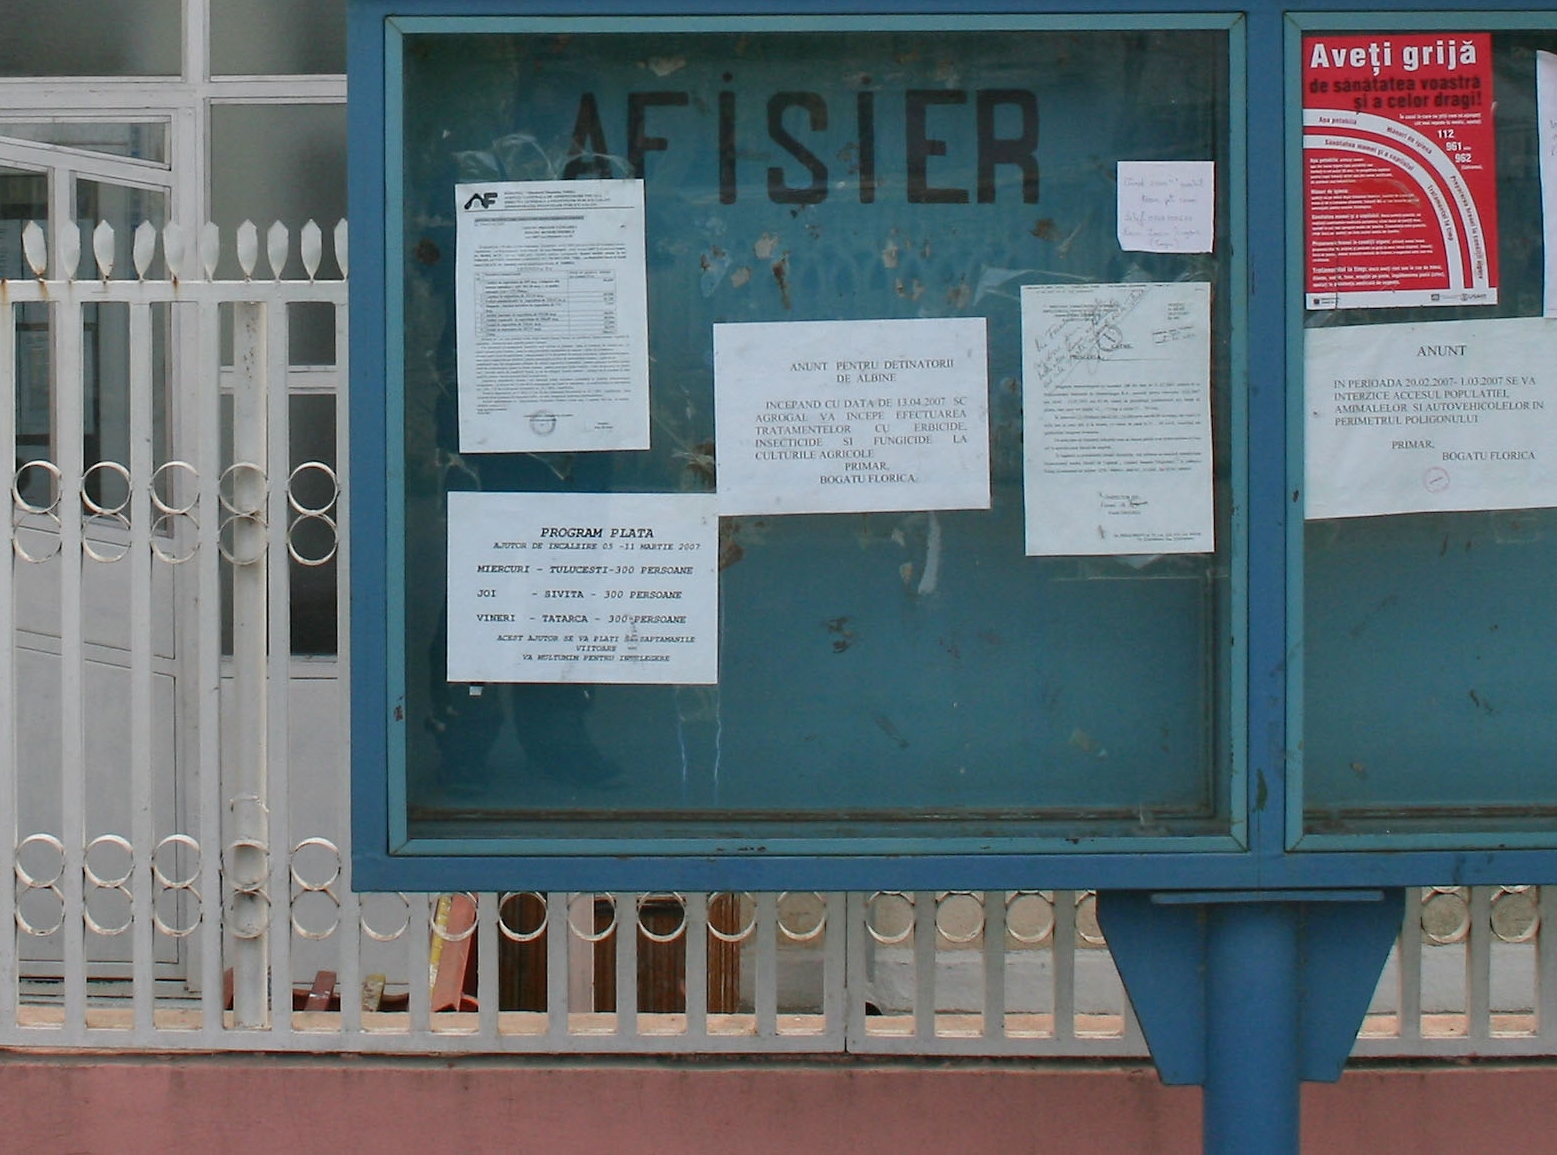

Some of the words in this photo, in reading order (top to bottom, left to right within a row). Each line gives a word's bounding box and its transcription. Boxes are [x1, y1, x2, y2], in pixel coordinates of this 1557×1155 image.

[1402, 40, 1477, 71] grijă
[1309, 78, 1328, 93] de
[1373, 97, 1382, 108] a
[1387, 94, 1430, 108] celor
[1438, 129, 1455, 138] 112
[1417, 345, 1467, 357] ANUNT
[790, 362, 828, 371] ANUNT
[836, 360, 878, 370] PENTRU
[884, 359, 954, 369] DETINATORII
[836, 374, 850, 383] DE
[857, 373, 897, 383] ALBINE
[1334, 380, 1345, 389] IN
[1348, 379, 1402, 388] PERIOADA
[1506, 376, 1518, 385] SE
[1521, 376, 1536, 385] VA
[1334, 391, 1390, 401] INTERZICE
[1394, 390, 1441, 400] ACCESUL
[766, 400, 821, 409] INCEPAND
[825, 400, 840, 408] CU
[844, 399, 874, 408] DATA
[878, 398, 892, 407] DE
[953, 397, 968, 405] SC
[1412, 403, 1422, 412] SI
[1532, 401, 1544, 410] IN
[755, 413, 808, 423] AGROGAL
[820, 413, 835, 421] VA
[846, 412, 884, 421] INCEPE
[896, 409, 967, 420] EFECTUAREA
[1335, 416, 1402, 426] PERIMETRUL
[1405, 415, 1478, 425] POLIGONULUI
[755, 425, 851, 435] TRATAMENTELOR
[875, 424, 890, 433] CU
[755, 438, 823, 448] INSECTICIDE
[843, 437, 853, 445] SI
[874, 435, 932, 445] FUNGICIDE
[953, 435, 967, 444] LA
[755, 450, 816, 461] CULTURILE
[819, 449, 874, 459] AGRICOLE
[1442, 451, 1487, 461] BOGATU
[1490, 451, 1536, 460] FLORICA
[820, 474, 865, 484] BOGATU
[868, 474, 916, 483] FLORICA
[540, 527, 603, 538] PROGRAM
[610, 528, 654, 538] PLATA
[678, 543, 701, 551] 2007
[477, 565, 530, 573] MIERCURI
[641, 566, 693, 574] PERSOANE
[477, 590, 496, 598] JOI
[544, 590, 584, 598] SIVITA
[604, 590, 624, 599] 300
[630, 591, 683, 599] PERSOANE
[476, 614, 515, 622] VINERI
[542, 615, 588, 623] TATARCA
